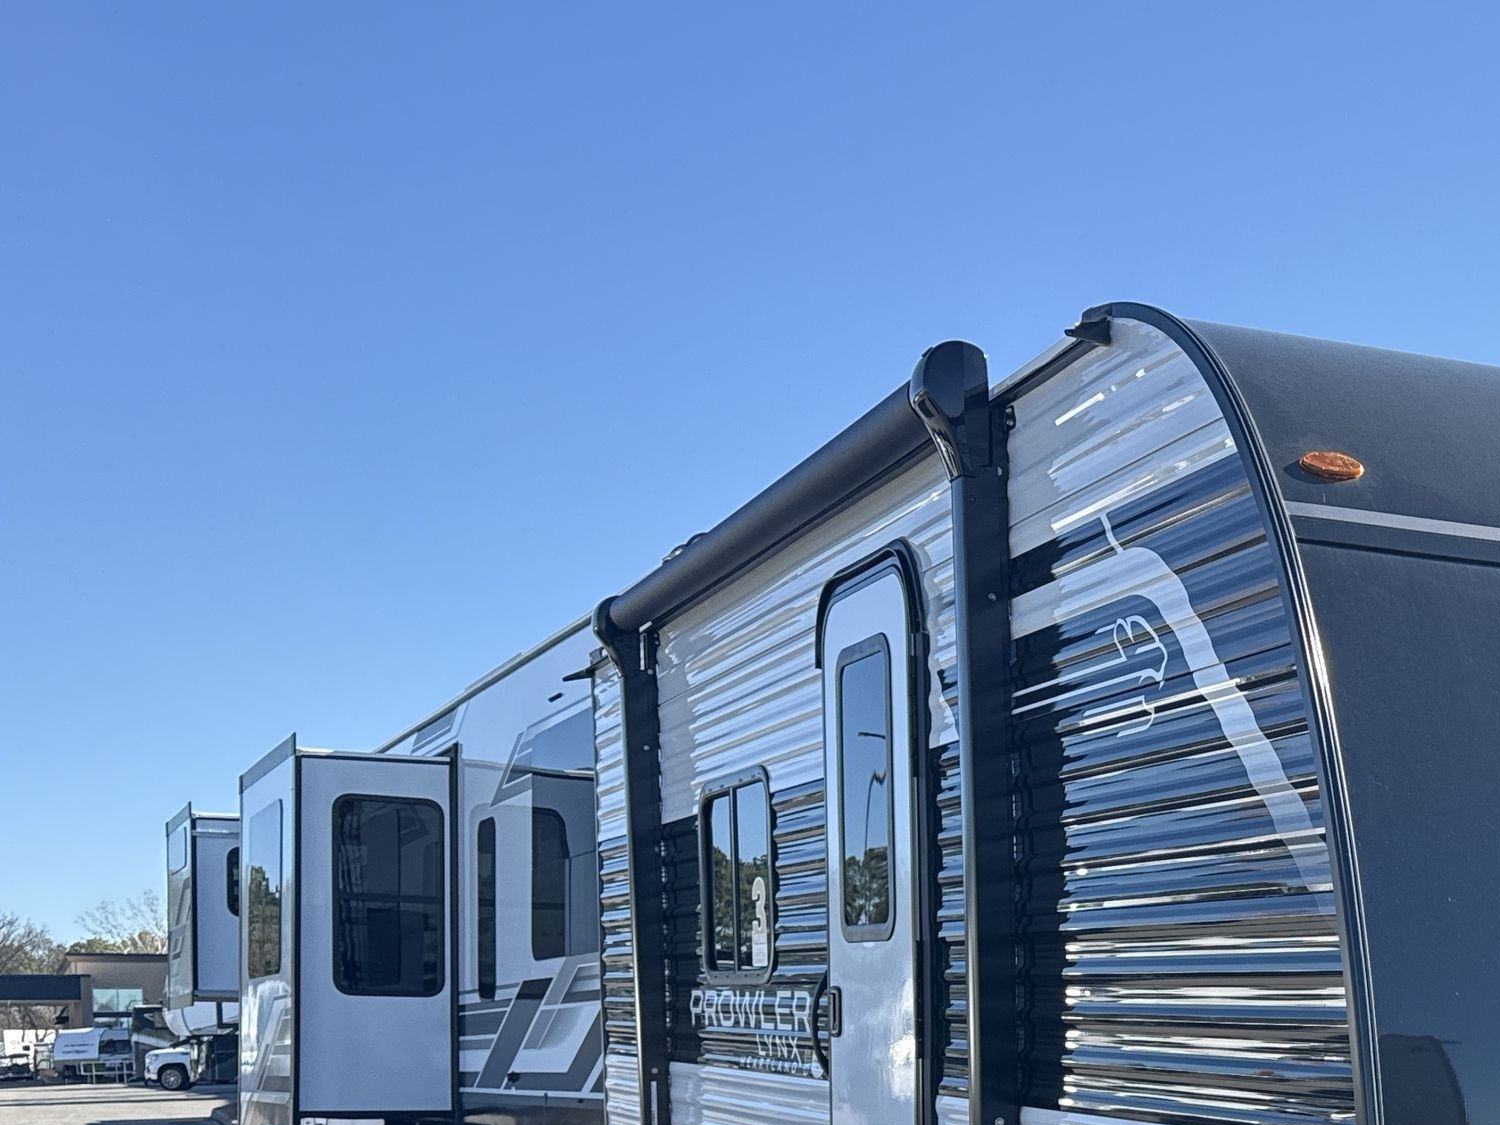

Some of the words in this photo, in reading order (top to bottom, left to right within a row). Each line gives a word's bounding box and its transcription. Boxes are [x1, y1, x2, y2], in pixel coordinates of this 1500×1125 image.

[690, 989, 812, 1033] PROWLER
[740, 1056, 798, 1074] HEARTLAND
[756, 1034, 802, 1067] LYNX
